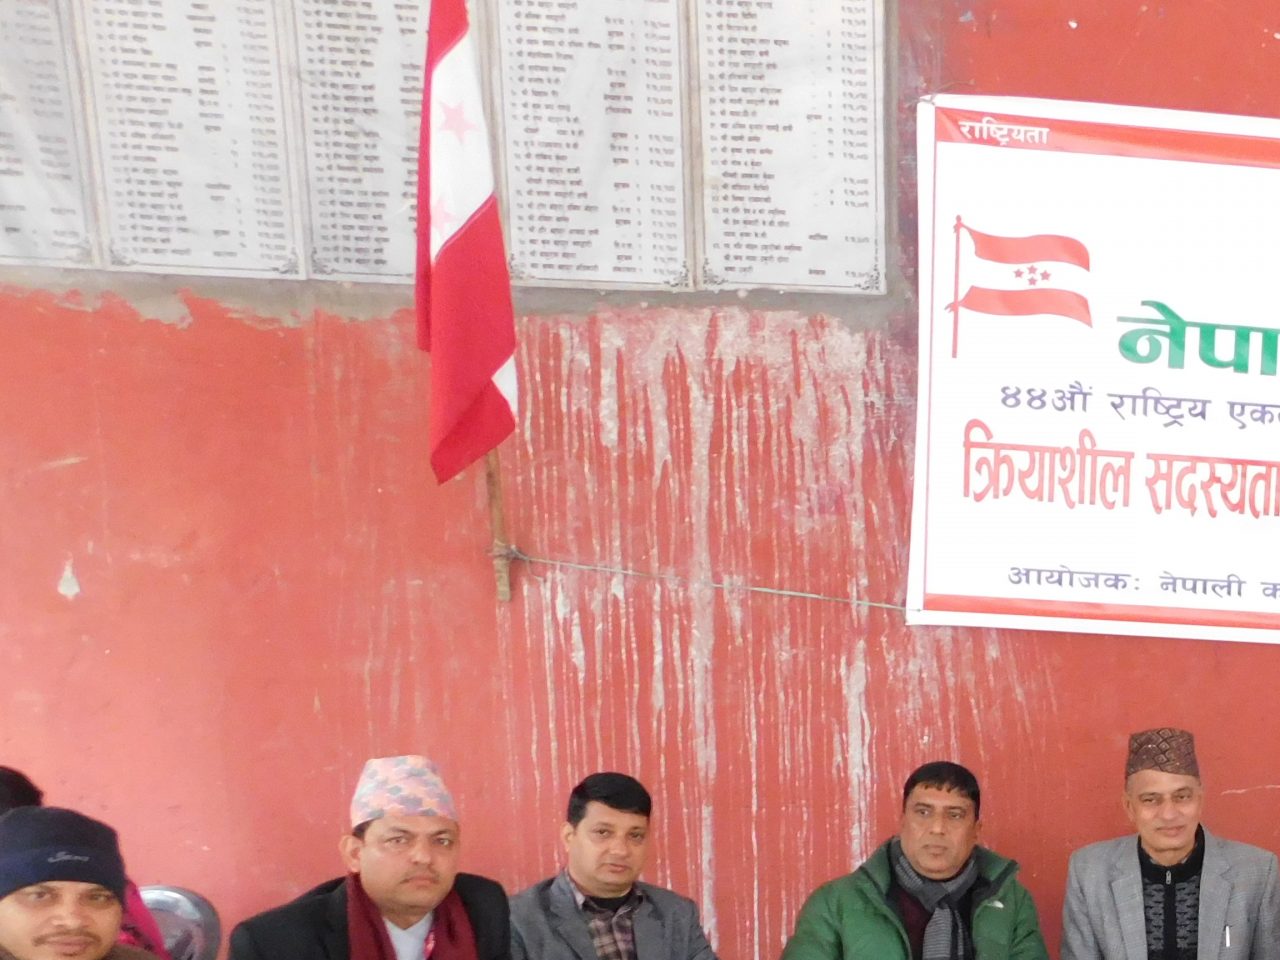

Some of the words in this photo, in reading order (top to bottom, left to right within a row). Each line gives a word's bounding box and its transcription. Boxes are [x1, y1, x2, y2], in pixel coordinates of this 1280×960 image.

[959, 117, 1050, 146] राष्ट्रियता
[1107, 387, 1211, 427] राष्ट्रिय
[963, 418, 1134, 509] क्रियाशील
[1159, 571, 1246, 597] नेपाली
